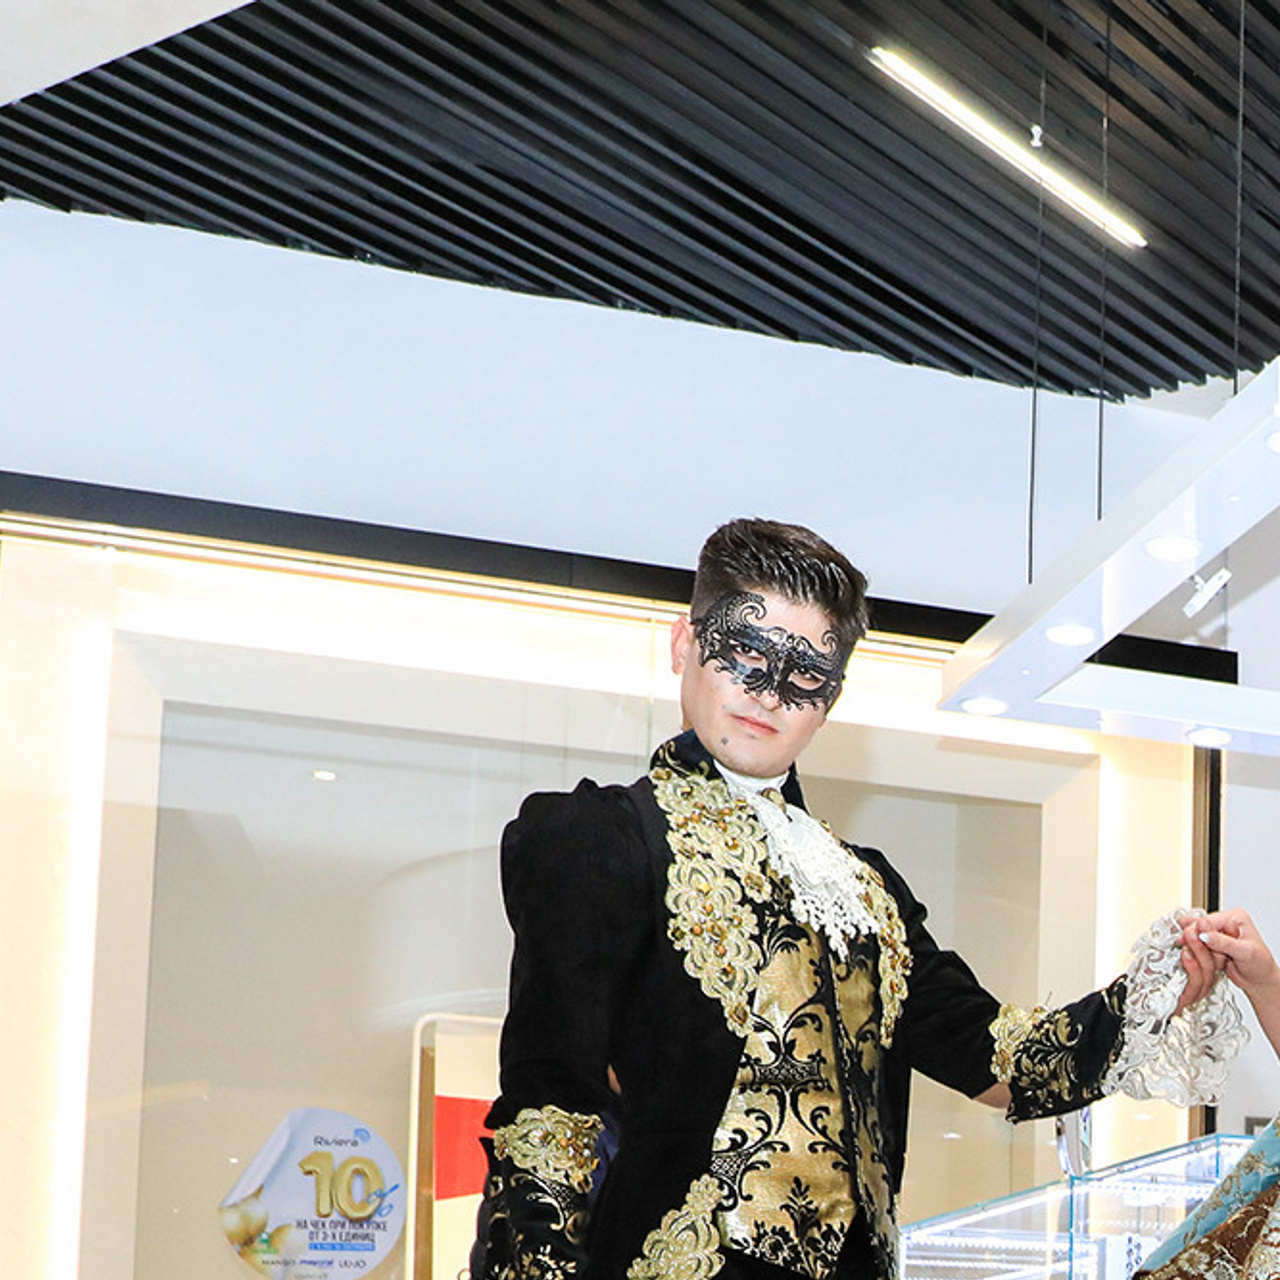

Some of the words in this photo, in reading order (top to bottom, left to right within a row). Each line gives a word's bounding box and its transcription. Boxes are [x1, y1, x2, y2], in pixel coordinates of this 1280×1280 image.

[296, 1219, 309, 1230] НА
[310, 1219, 328, 1230] ЧЕК
[329, 1219, 347, 1230] ПРИ
[308, 1231, 320, 1241] ОТ
